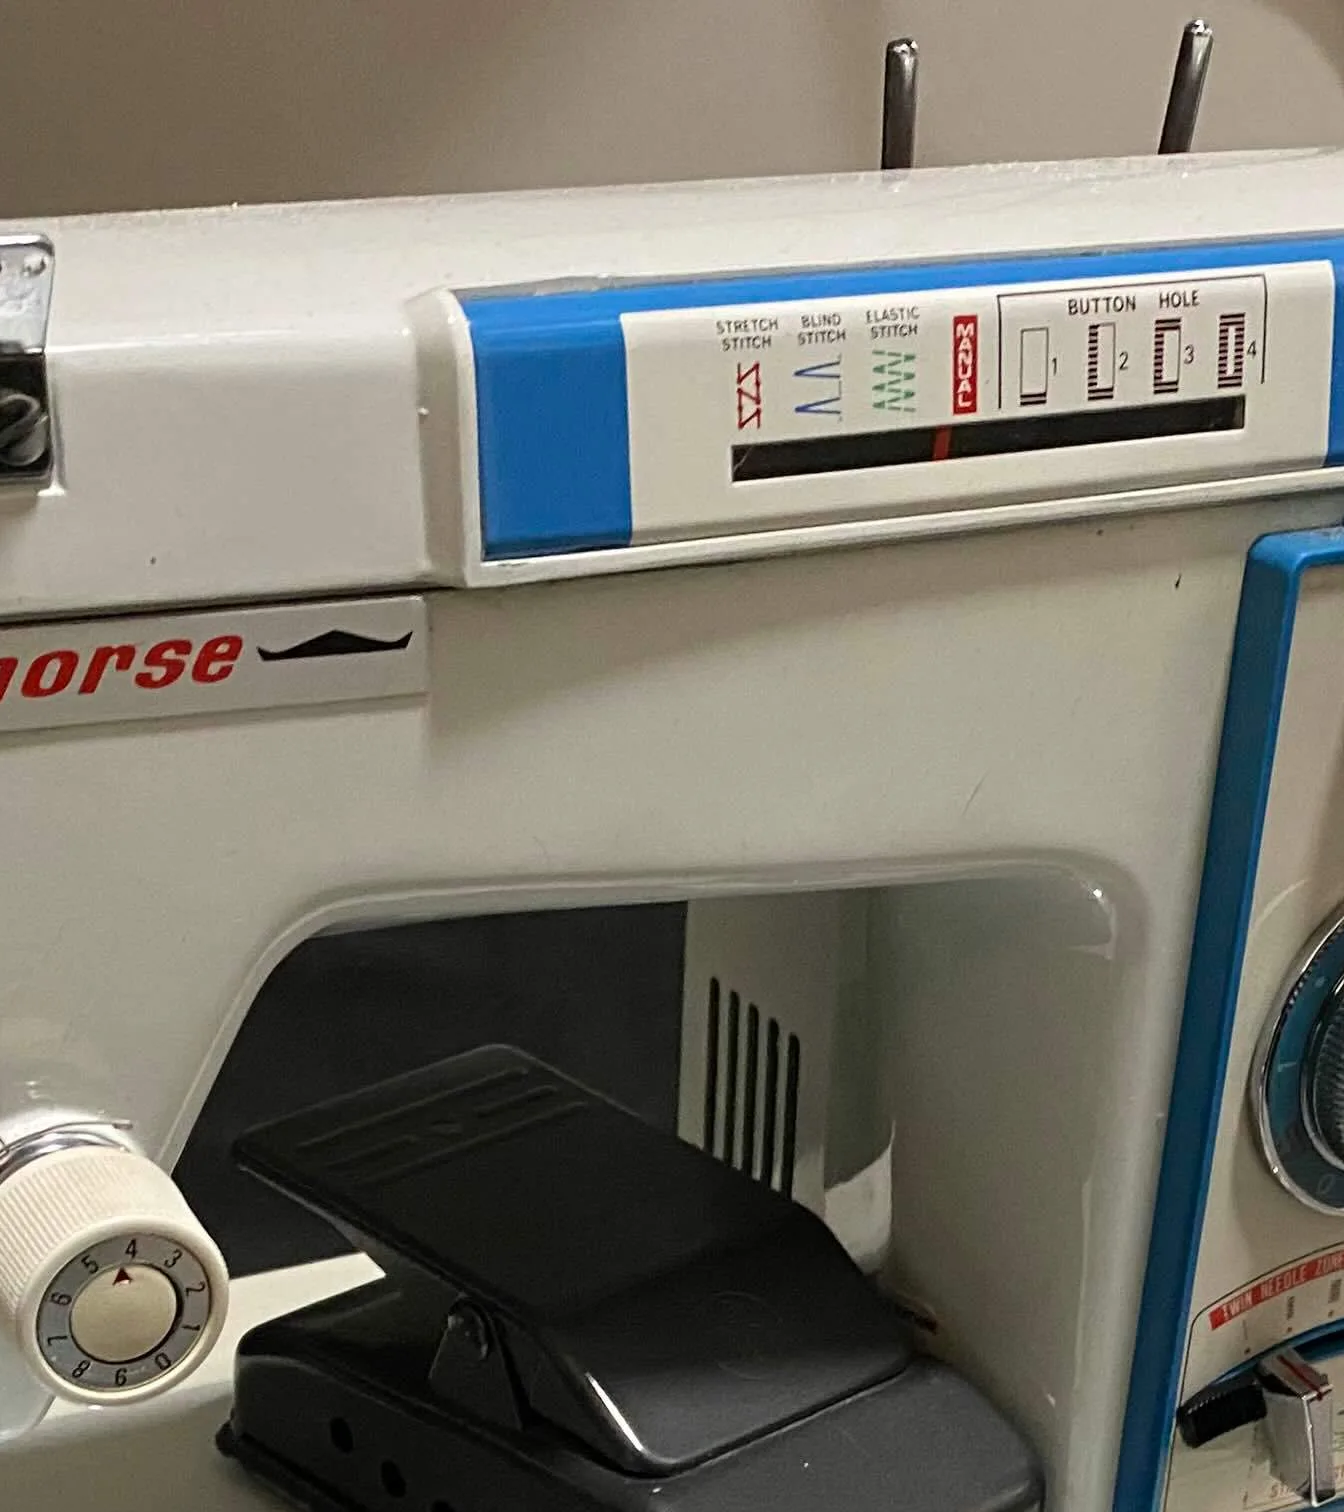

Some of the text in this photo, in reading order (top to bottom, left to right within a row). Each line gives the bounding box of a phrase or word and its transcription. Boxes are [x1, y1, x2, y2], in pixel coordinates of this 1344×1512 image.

[1068, 290, 1201, 317] BUTTON HOLE
[800, 312, 842, 329] BLIND
[865, 306, 920, 325] ELASTIC
[716, 317, 779, 336] STRETCH
[797, 326, 846, 344] STITCH
[870, 322, 919, 340] STITCH
[721, 333, 774, 351] STITCH
[1246, 340, 1257, 359] 4
[1118, 351, 1130, 371] 2
[1183, 345, 1195, 365] 3
[955, 323, 975, 408] MANUAL
[125, 1238, 137, 1260] 4
[80, 1255, 100, 1275] 5
[164, 1249, 184, 1269] 3
[50, 1290, 73, 1306] 6
[185, 1281, 206, 1297] 2
[72, 1359, 91, 1379] 8
